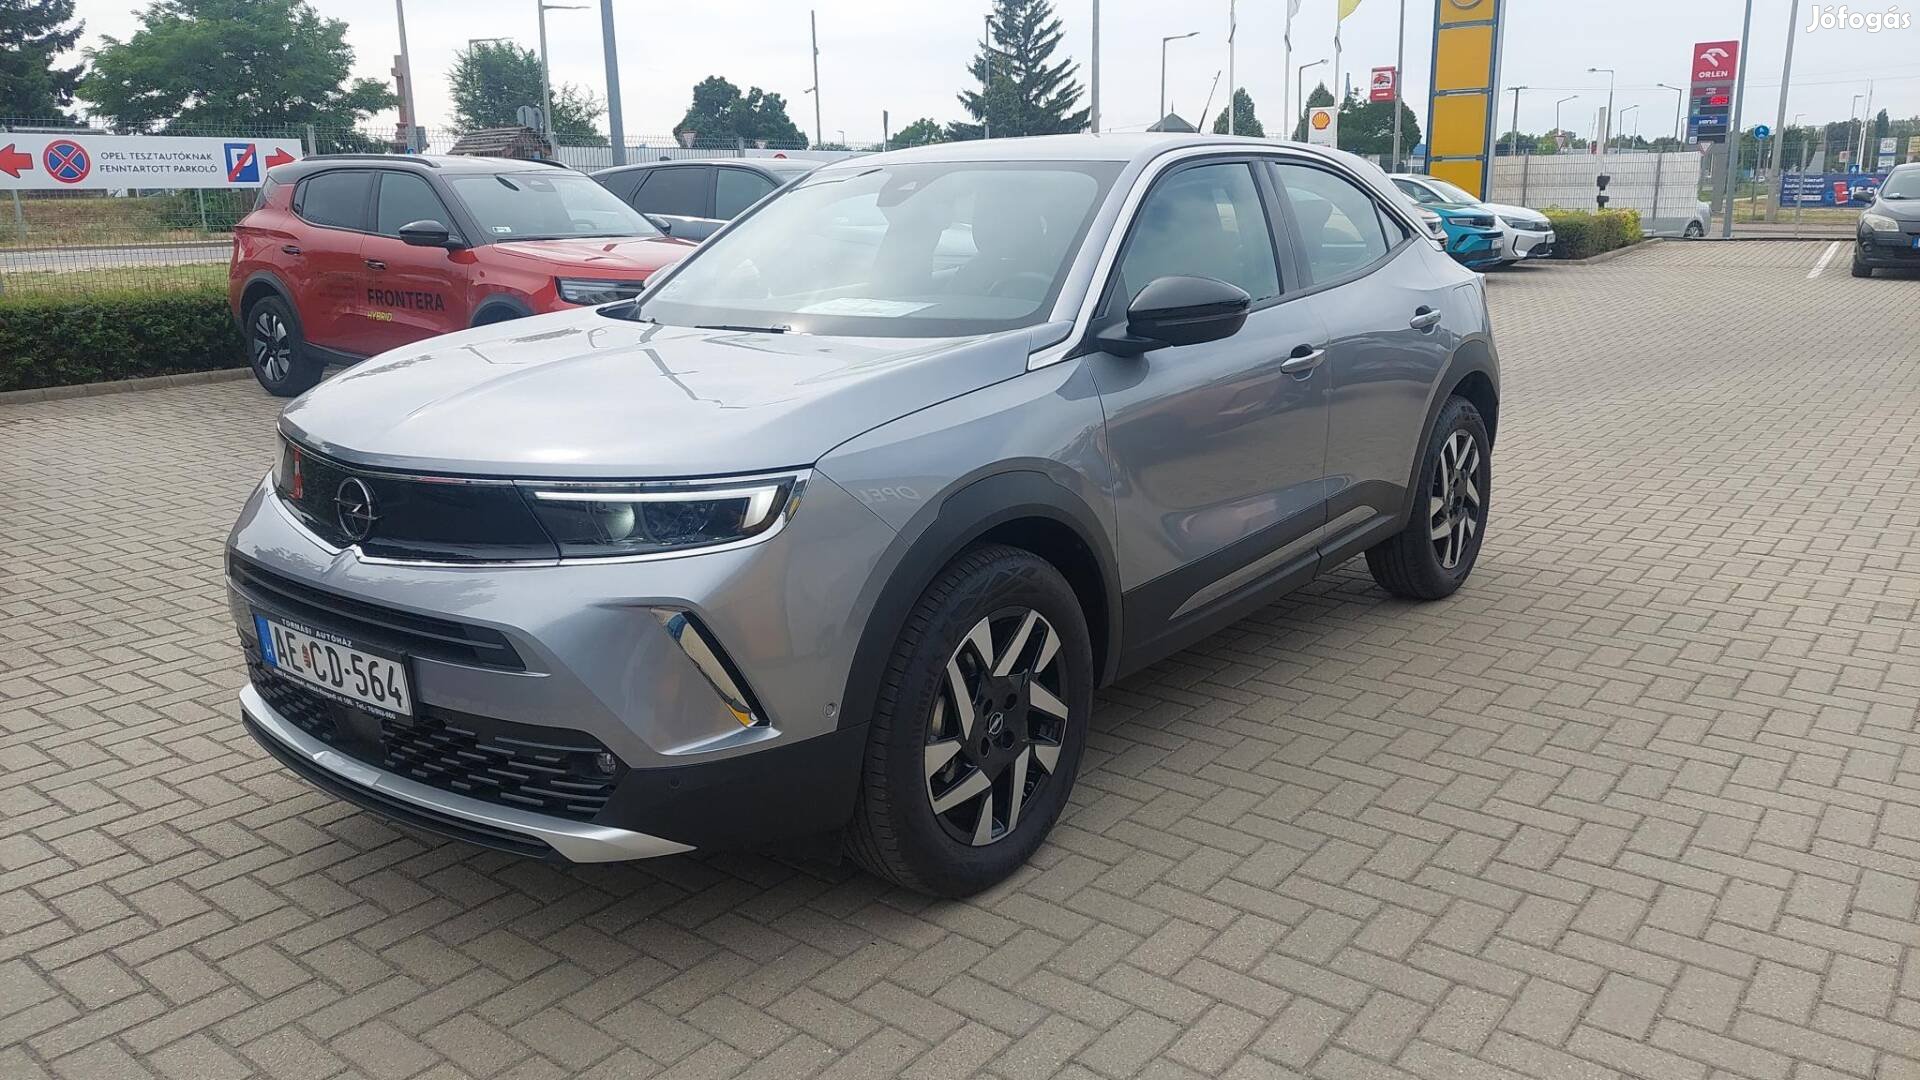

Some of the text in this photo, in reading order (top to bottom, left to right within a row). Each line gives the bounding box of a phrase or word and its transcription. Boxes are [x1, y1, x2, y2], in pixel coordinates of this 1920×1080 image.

[1698, 70, 1729, 78] ORLEN
[100, 151, 213, 160] OPEL TESZTAUTÓKNAK
[99, 163, 218, 173] FENNTARTOTT PARKOLÓ
[367, 288, 445, 312] FRONTERA
[367, 311, 393, 322] HYBRID
[315, 631, 353, 648] AUTÓHÁZ
[265, 644, 273, 658] H
[273, 626, 403, 708] AE CD-564
